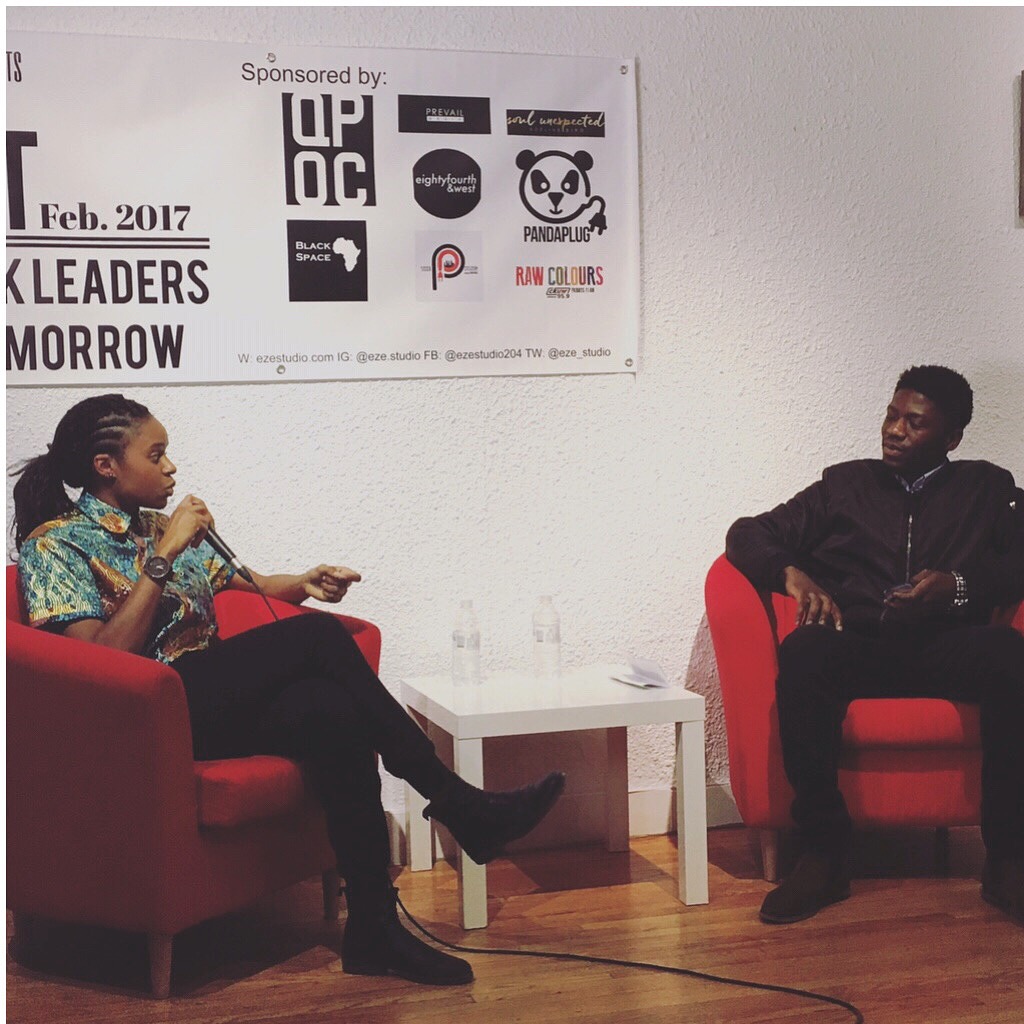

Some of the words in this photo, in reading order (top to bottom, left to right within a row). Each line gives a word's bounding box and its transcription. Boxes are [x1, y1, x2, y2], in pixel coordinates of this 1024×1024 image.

[241, 62, 351, 85] Sponsored
[358, 66, 387, 89] by:
[425, 107, 464, 116] PREVAIL
[507, 110, 536, 126] soul
[415, 173, 477, 187] eightyfourth
[446, 183, 476, 193] &west
[39, 202, 108, 230] Feb.
[115, 204, 191, 231] 2017
[523, 225, 591, 243] PANDAPLUG
[33, 259, 210, 304] LEADERS
[516, 266, 544, 286] RAW
[548, 266, 604, 286] COLOURS
[6, 325, 184, 371] MORROW
[256, 352, 334, 364] ezestudio.com
[337, 352, 353, 362] IG:
[356, 351, 421, 364] @eze.studio
[424, 349, 442, 360] FB:
[444, 348, 522, 362] @ezestudio204
[548, 347, 612, 361] @eze_studio
